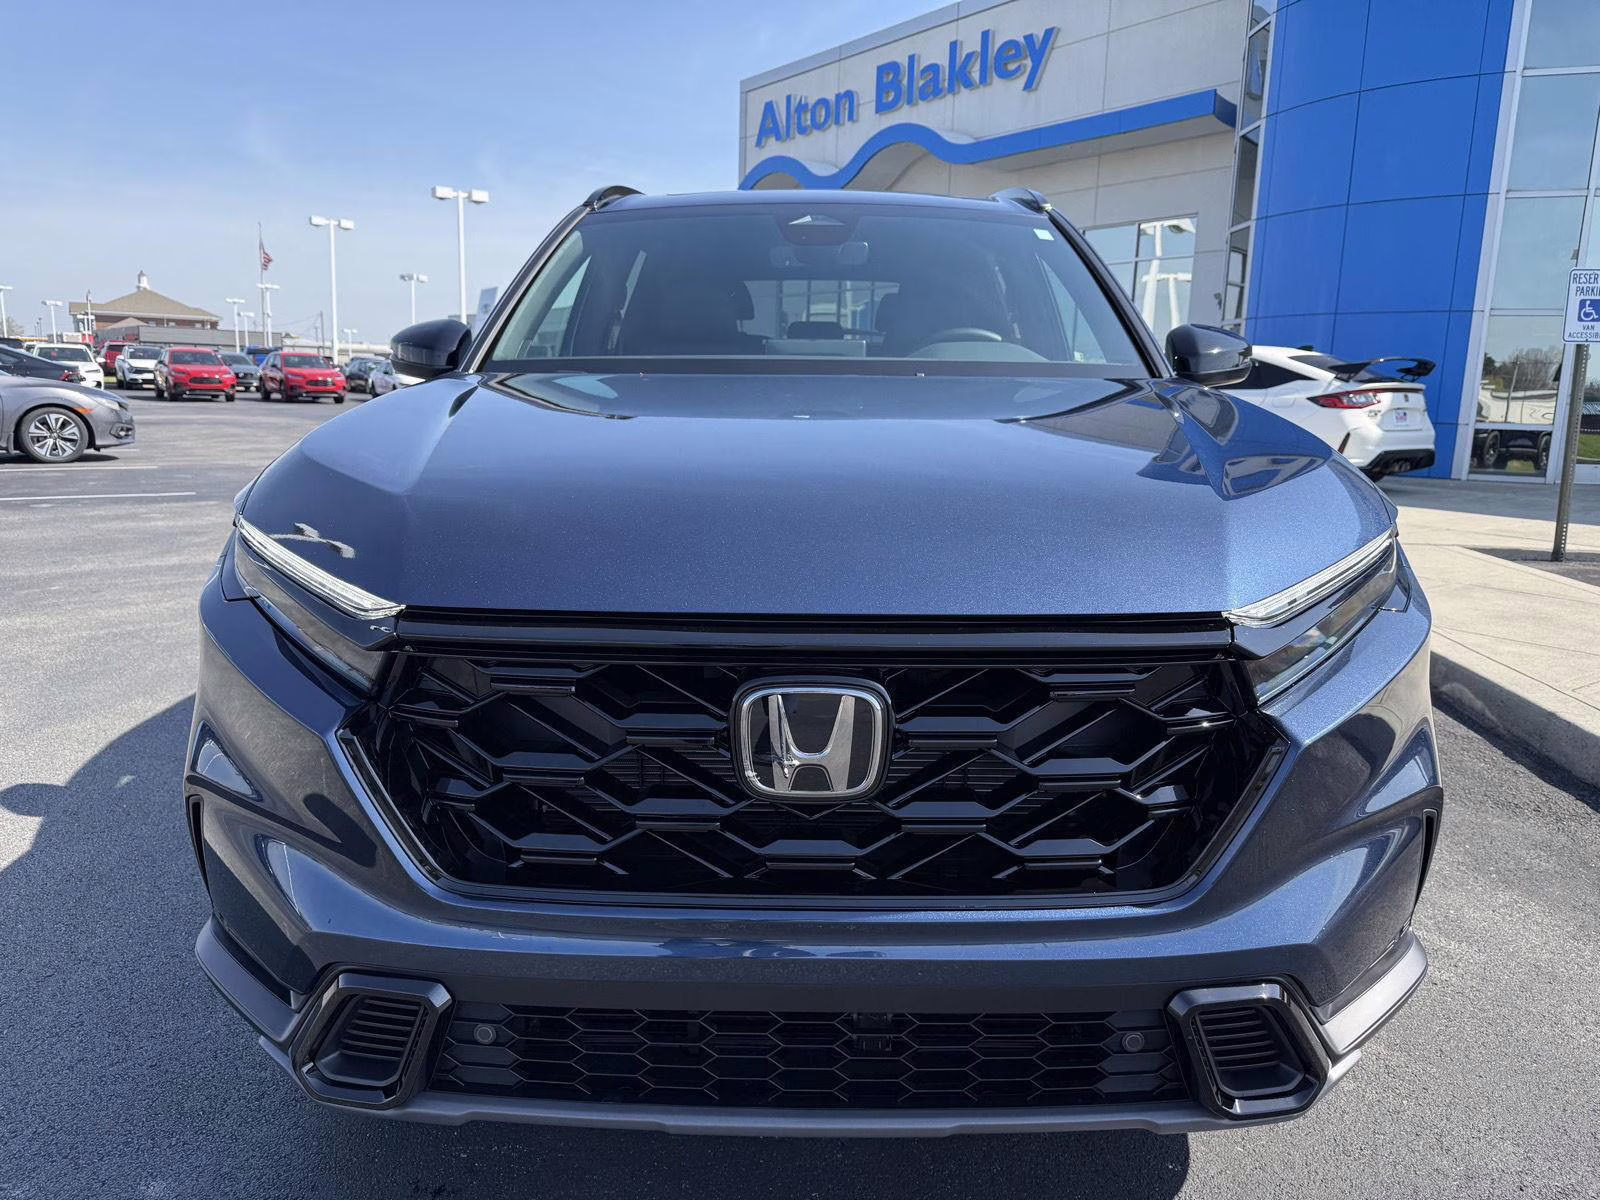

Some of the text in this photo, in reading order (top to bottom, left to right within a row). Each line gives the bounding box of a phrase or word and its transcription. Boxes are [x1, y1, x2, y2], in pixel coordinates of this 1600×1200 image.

[755, 26, 1059, 148] Alton Blakley
[1575, 285, 1600, 297] PARKI
